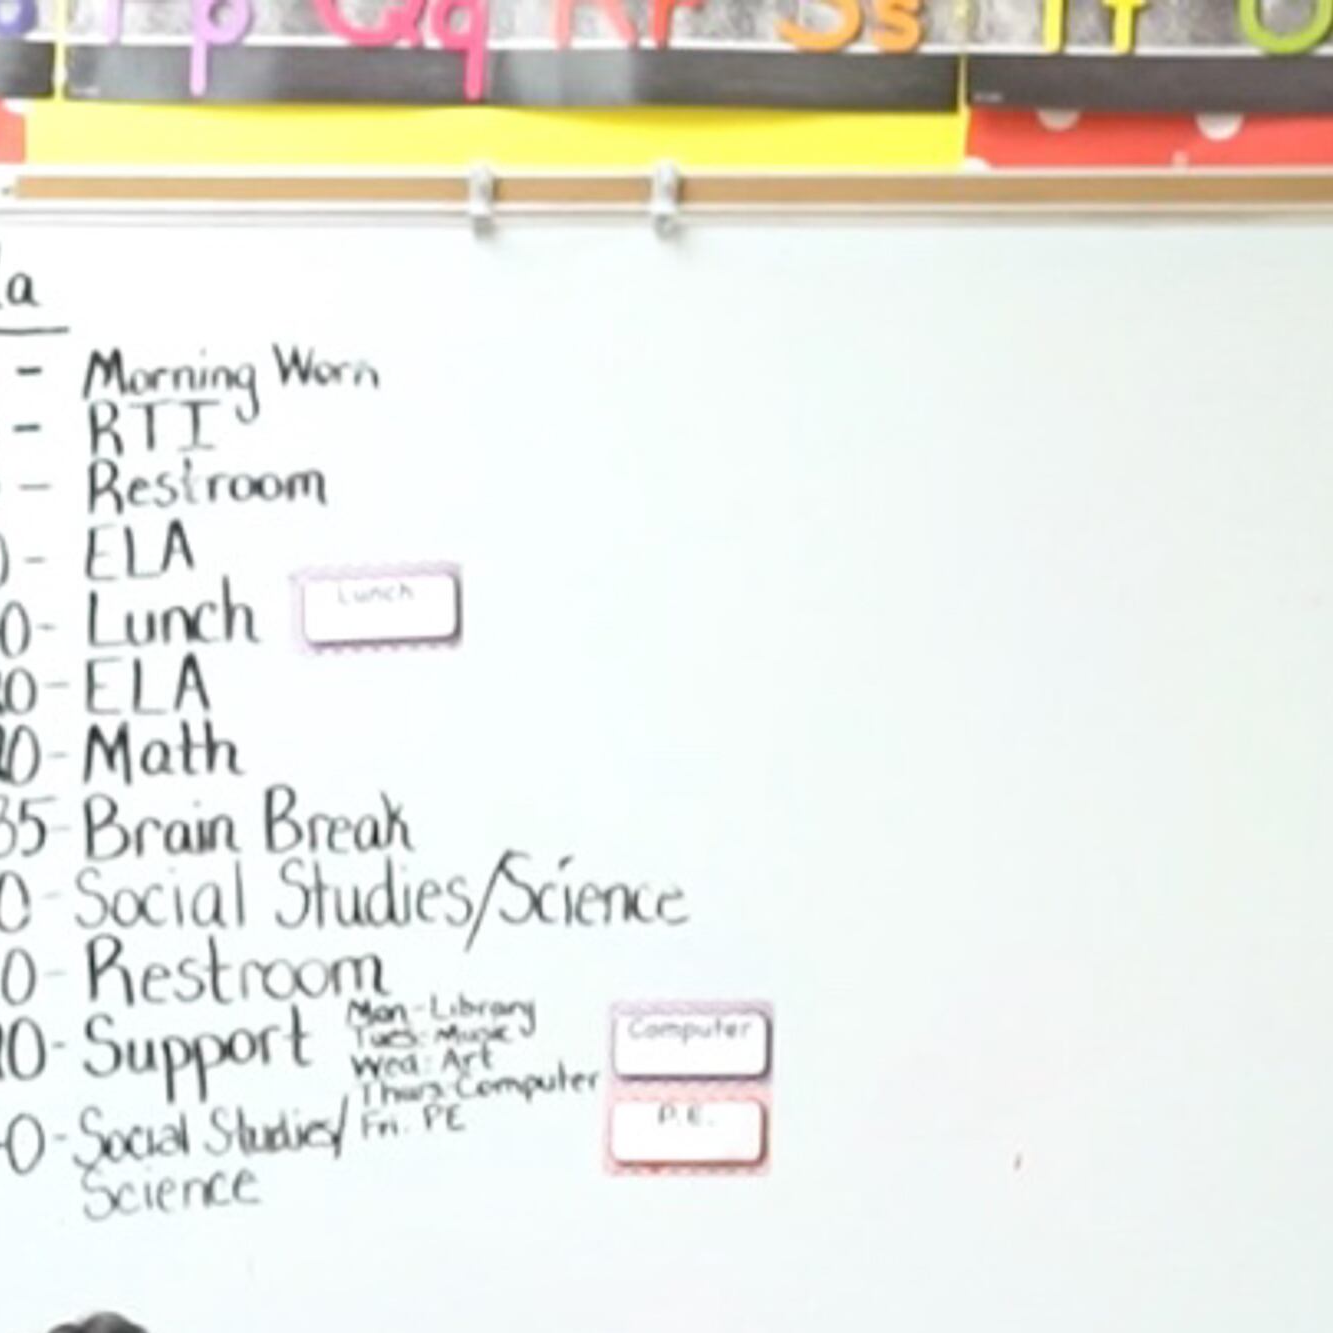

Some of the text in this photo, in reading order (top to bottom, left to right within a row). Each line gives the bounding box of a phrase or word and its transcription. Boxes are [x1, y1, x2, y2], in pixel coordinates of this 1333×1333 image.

[82, 346, 260, 425] Morning
[89, 399, 221, 457] RTI
[88, 456, 330, 517] Restroom
[85, 519, 196, 581] ELA
[87, 576, 261, 647] Lunch
[85, 652, 212, 715] ELA
[83, 718, 246, 786] Math
[83, 793, 237, 860] Brain
[263, 783, 415, 854] Break
[74, 861, 243, 930] Social
[86, 933, 391, 1006] Restroom
[431, 991, 537, 1038] Library
[627, 1014, 754, 1048] Computer
[84, 1002, 314, 1103] Support
[441, 1043, 493, 1074] Art
[455, 1058, 601, 1104] Computer
[72, 1104, 190, 1169] Social
[82, 1165, 263, 1223] Science
